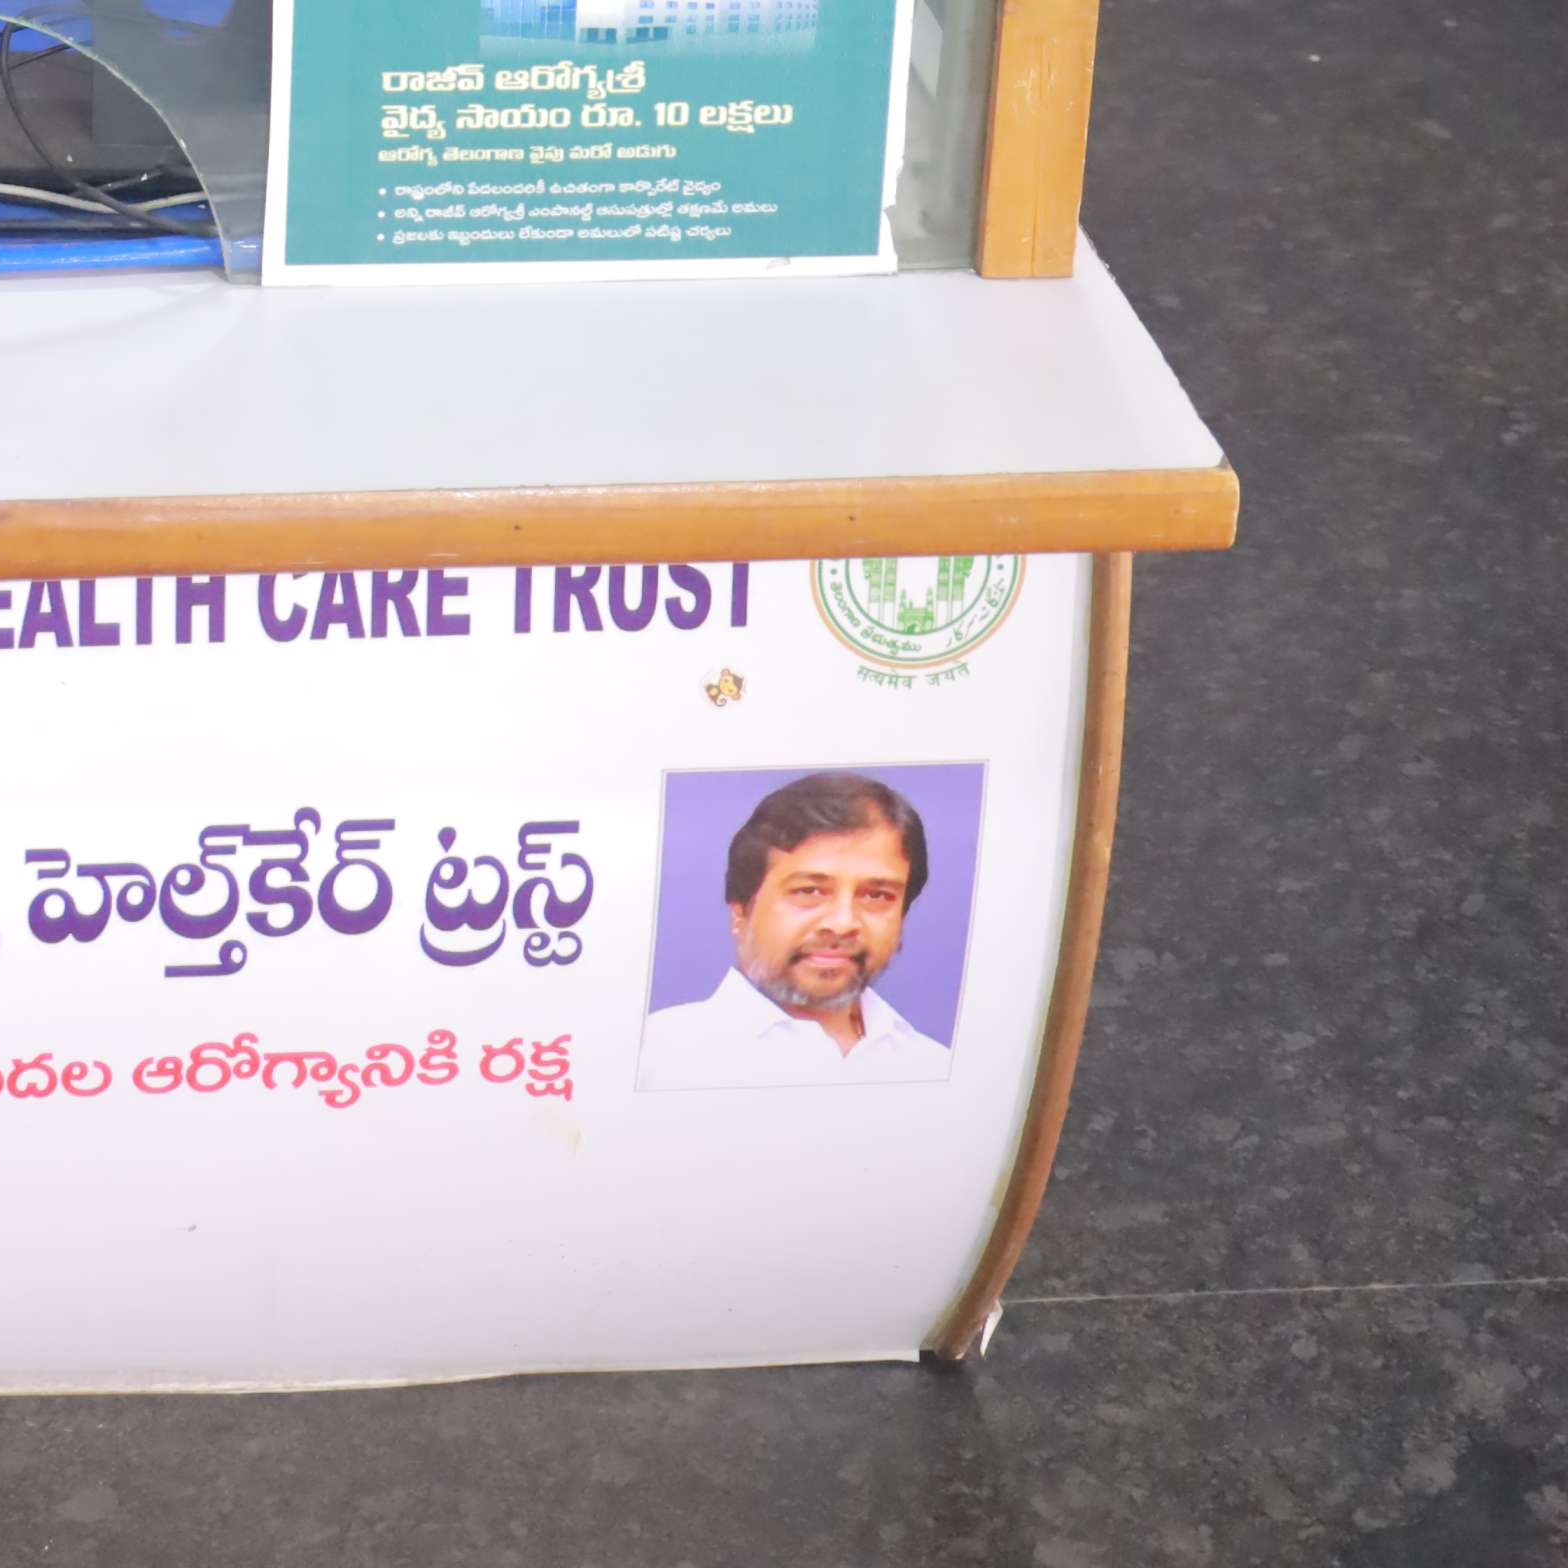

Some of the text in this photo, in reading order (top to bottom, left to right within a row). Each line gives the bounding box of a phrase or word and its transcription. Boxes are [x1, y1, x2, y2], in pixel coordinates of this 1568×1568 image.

[381, 98, 793, 140] వైద్య సాయం రూ. 10 లక్షలు
[382, 60, 646, 100] రాజీవ్ ఆరోగ్యశ్రీ
[258, 569, 470, 642] CARE
[515, 562, 749, 635] TRUST
[420, 821, 593, 967] ట్రస్ట్
[132, 1030, 459, 1108] ఆరోగ్యానికి
[480, 1035, 573, 1101] రక్ష
